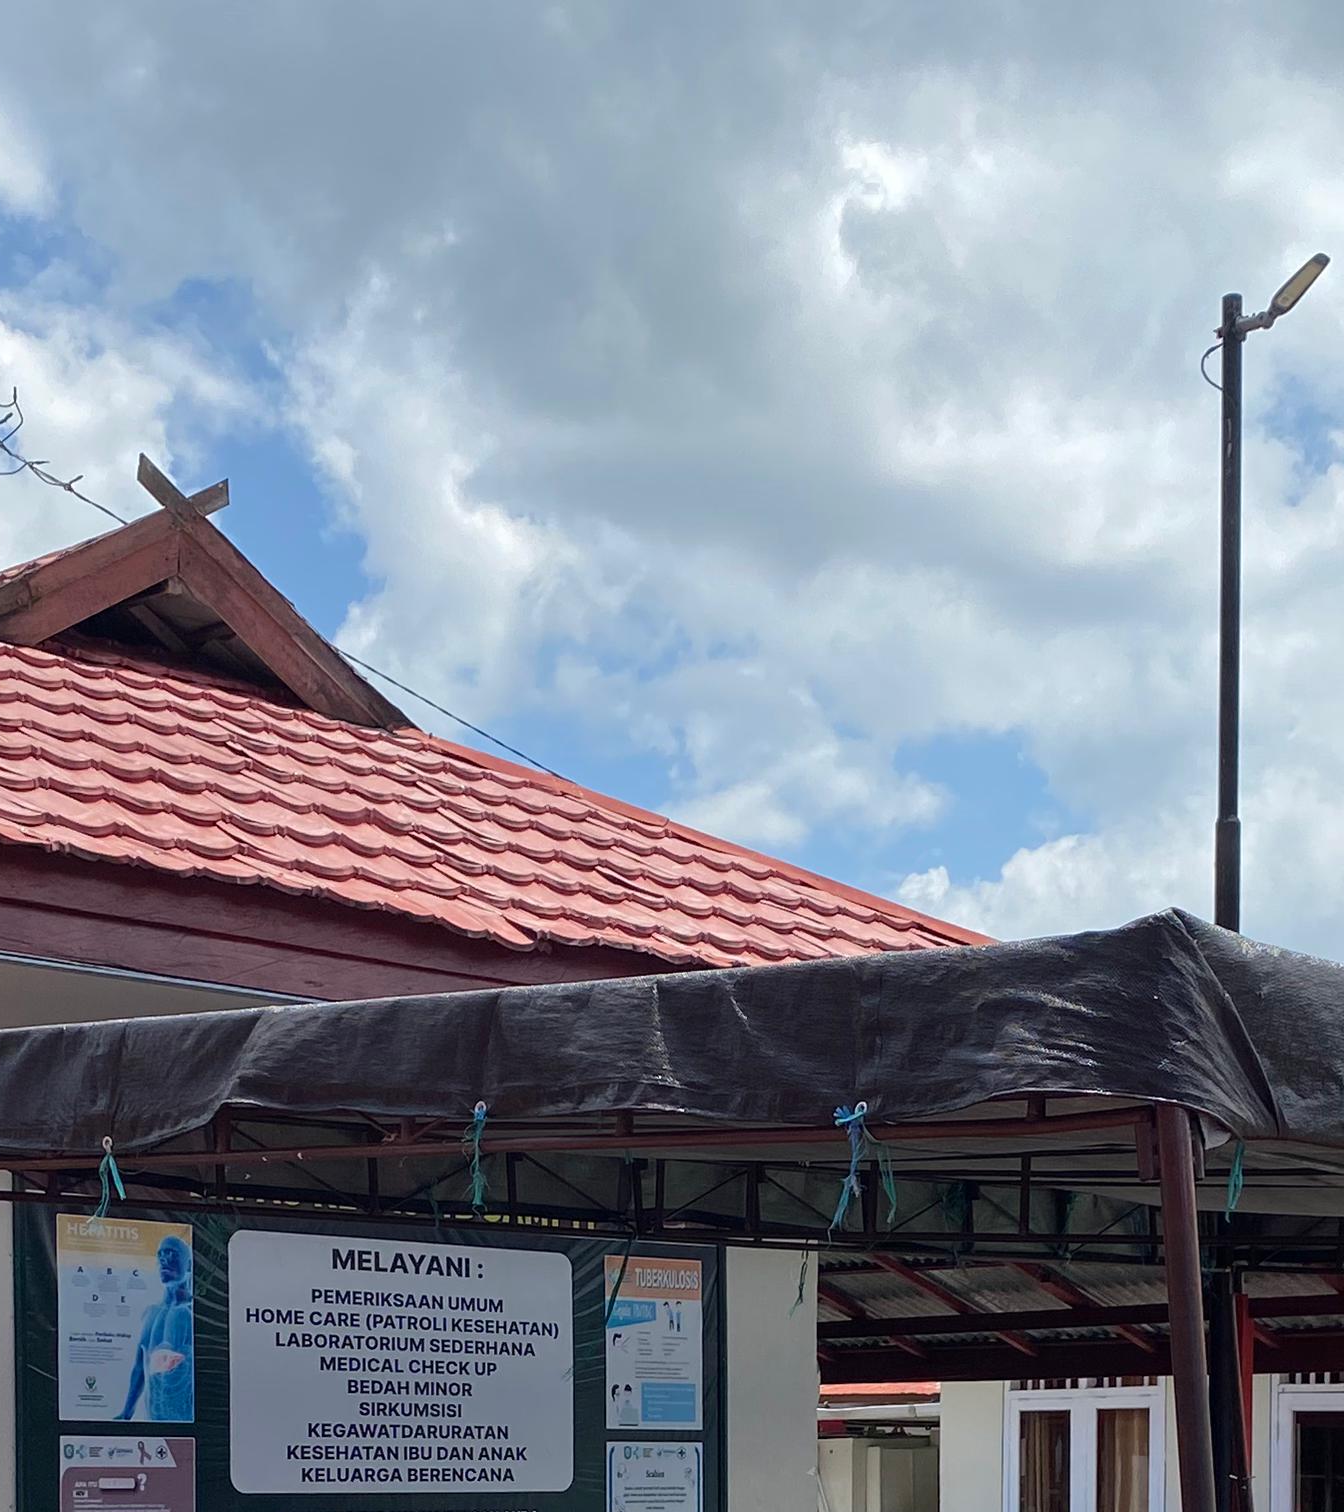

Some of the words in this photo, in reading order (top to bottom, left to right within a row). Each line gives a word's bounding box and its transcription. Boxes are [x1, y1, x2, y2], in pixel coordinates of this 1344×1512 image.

[332, 1248, 471, 1278] MELAYANI
[311, 1288, 444, 1310] PEMERIKSAAN
[448, 1296, 504, 1313] UMUM
[246, 1307, 305, 1325] HOME
[309, 1311, 360, 1328] CARE
[366, 1314, 447, 1332] (PATROLI
[451, 1318, 559, 1340] KESEHATAN)
[275, 1332, 425, 1353] LABORATORIUM
[429, 1338, 536, 1357] SEDERHANA
[319, 1356, 404, 1374] MEDICAL
[408, 1359, 471, 1376] CHECK
[474, 1361, 498, 1377] UP
[347, 1379, 410, 1396] BEDAH
[414, 1381, 473, 1397] MINOR
[359, 1402, 463, 1418] SIRKUMSISI
[308, 1422, 509, 1440] KEGAWATDARURATAN
[286, 1444, 400, 1461] KESEHATAN
[403, 1446, 433, 1461] IBU
[436, 1446, 474, 1461] DAN
[477, 1446, 528, 1461] ANAK
[301, 1467, 404, 1483] KELUARGA
[407, 1467, 515, 1483] BERENCANA
